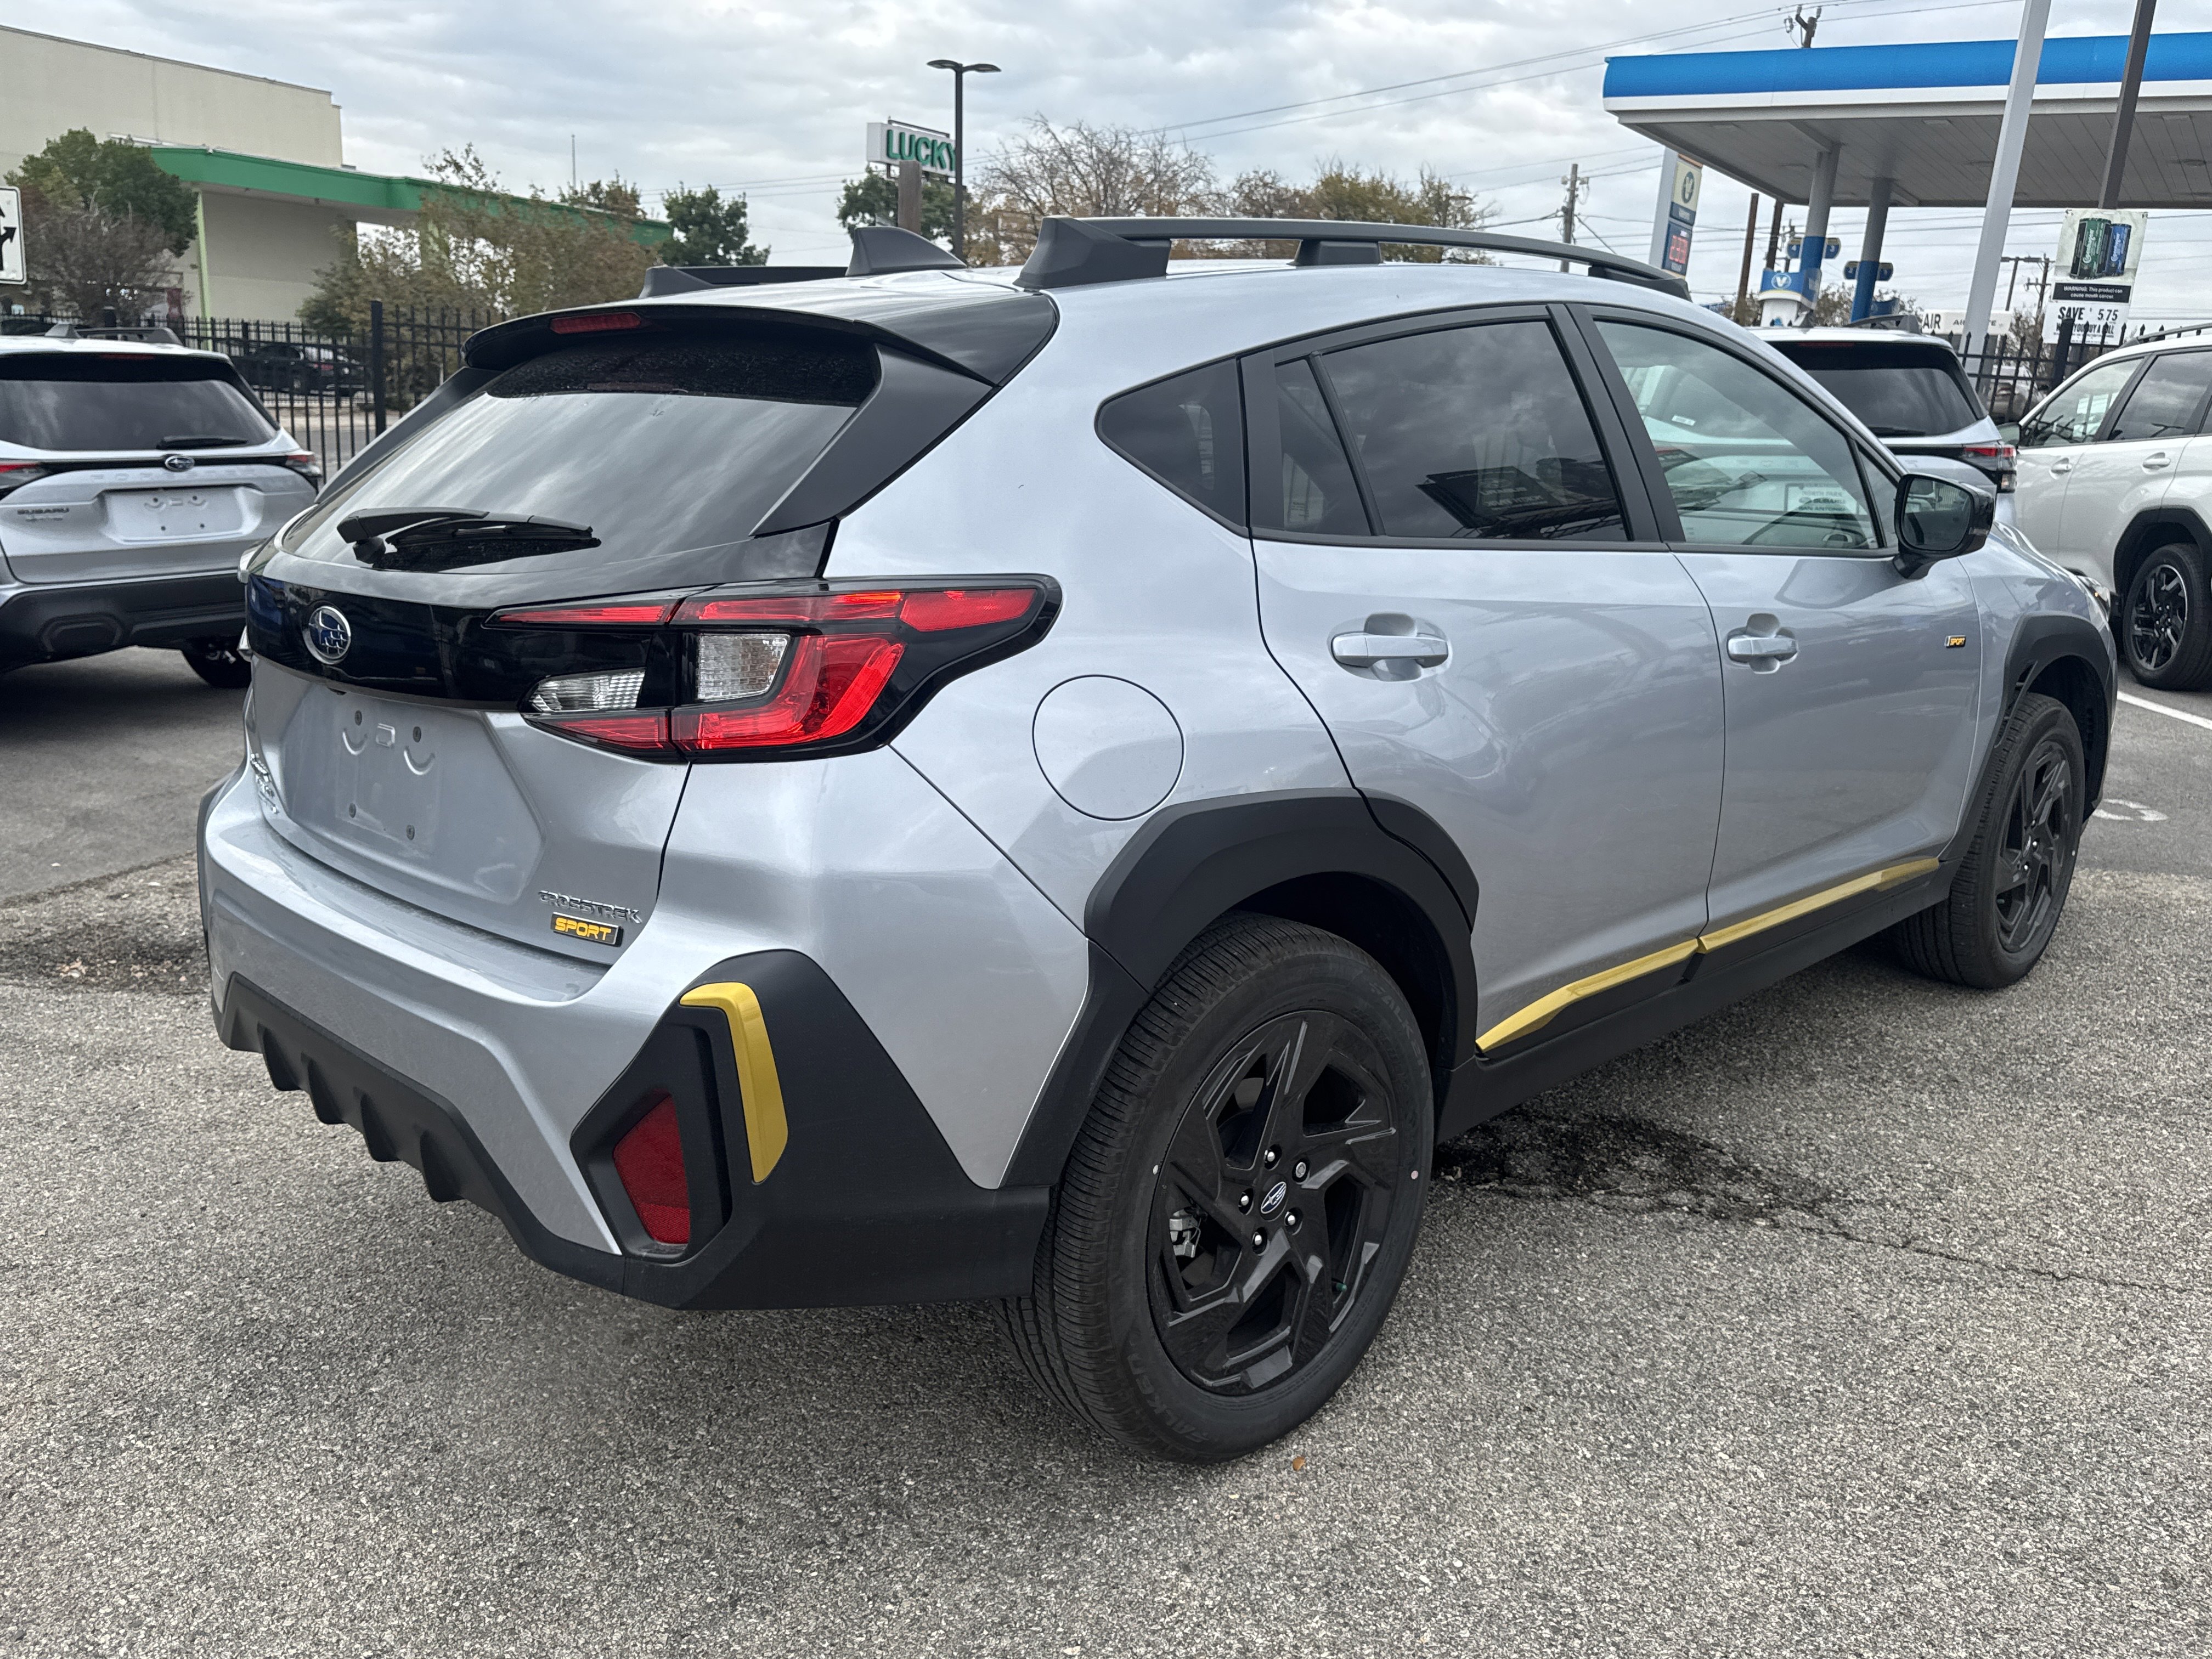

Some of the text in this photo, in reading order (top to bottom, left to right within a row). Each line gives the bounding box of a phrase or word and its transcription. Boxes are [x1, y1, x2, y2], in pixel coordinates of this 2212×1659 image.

[887, 129, 956, 171] LUCKY
[1922, 313, 1941, 329] AIR
[2058, 307, 2085, 320] SAVE
[2097, 324, 2101, 333] A
[1949, 637, 1965, 646] SPORT
[538, 890, 643, 924] CROSSTREK
[555, 917, 612, 941] SPORT
